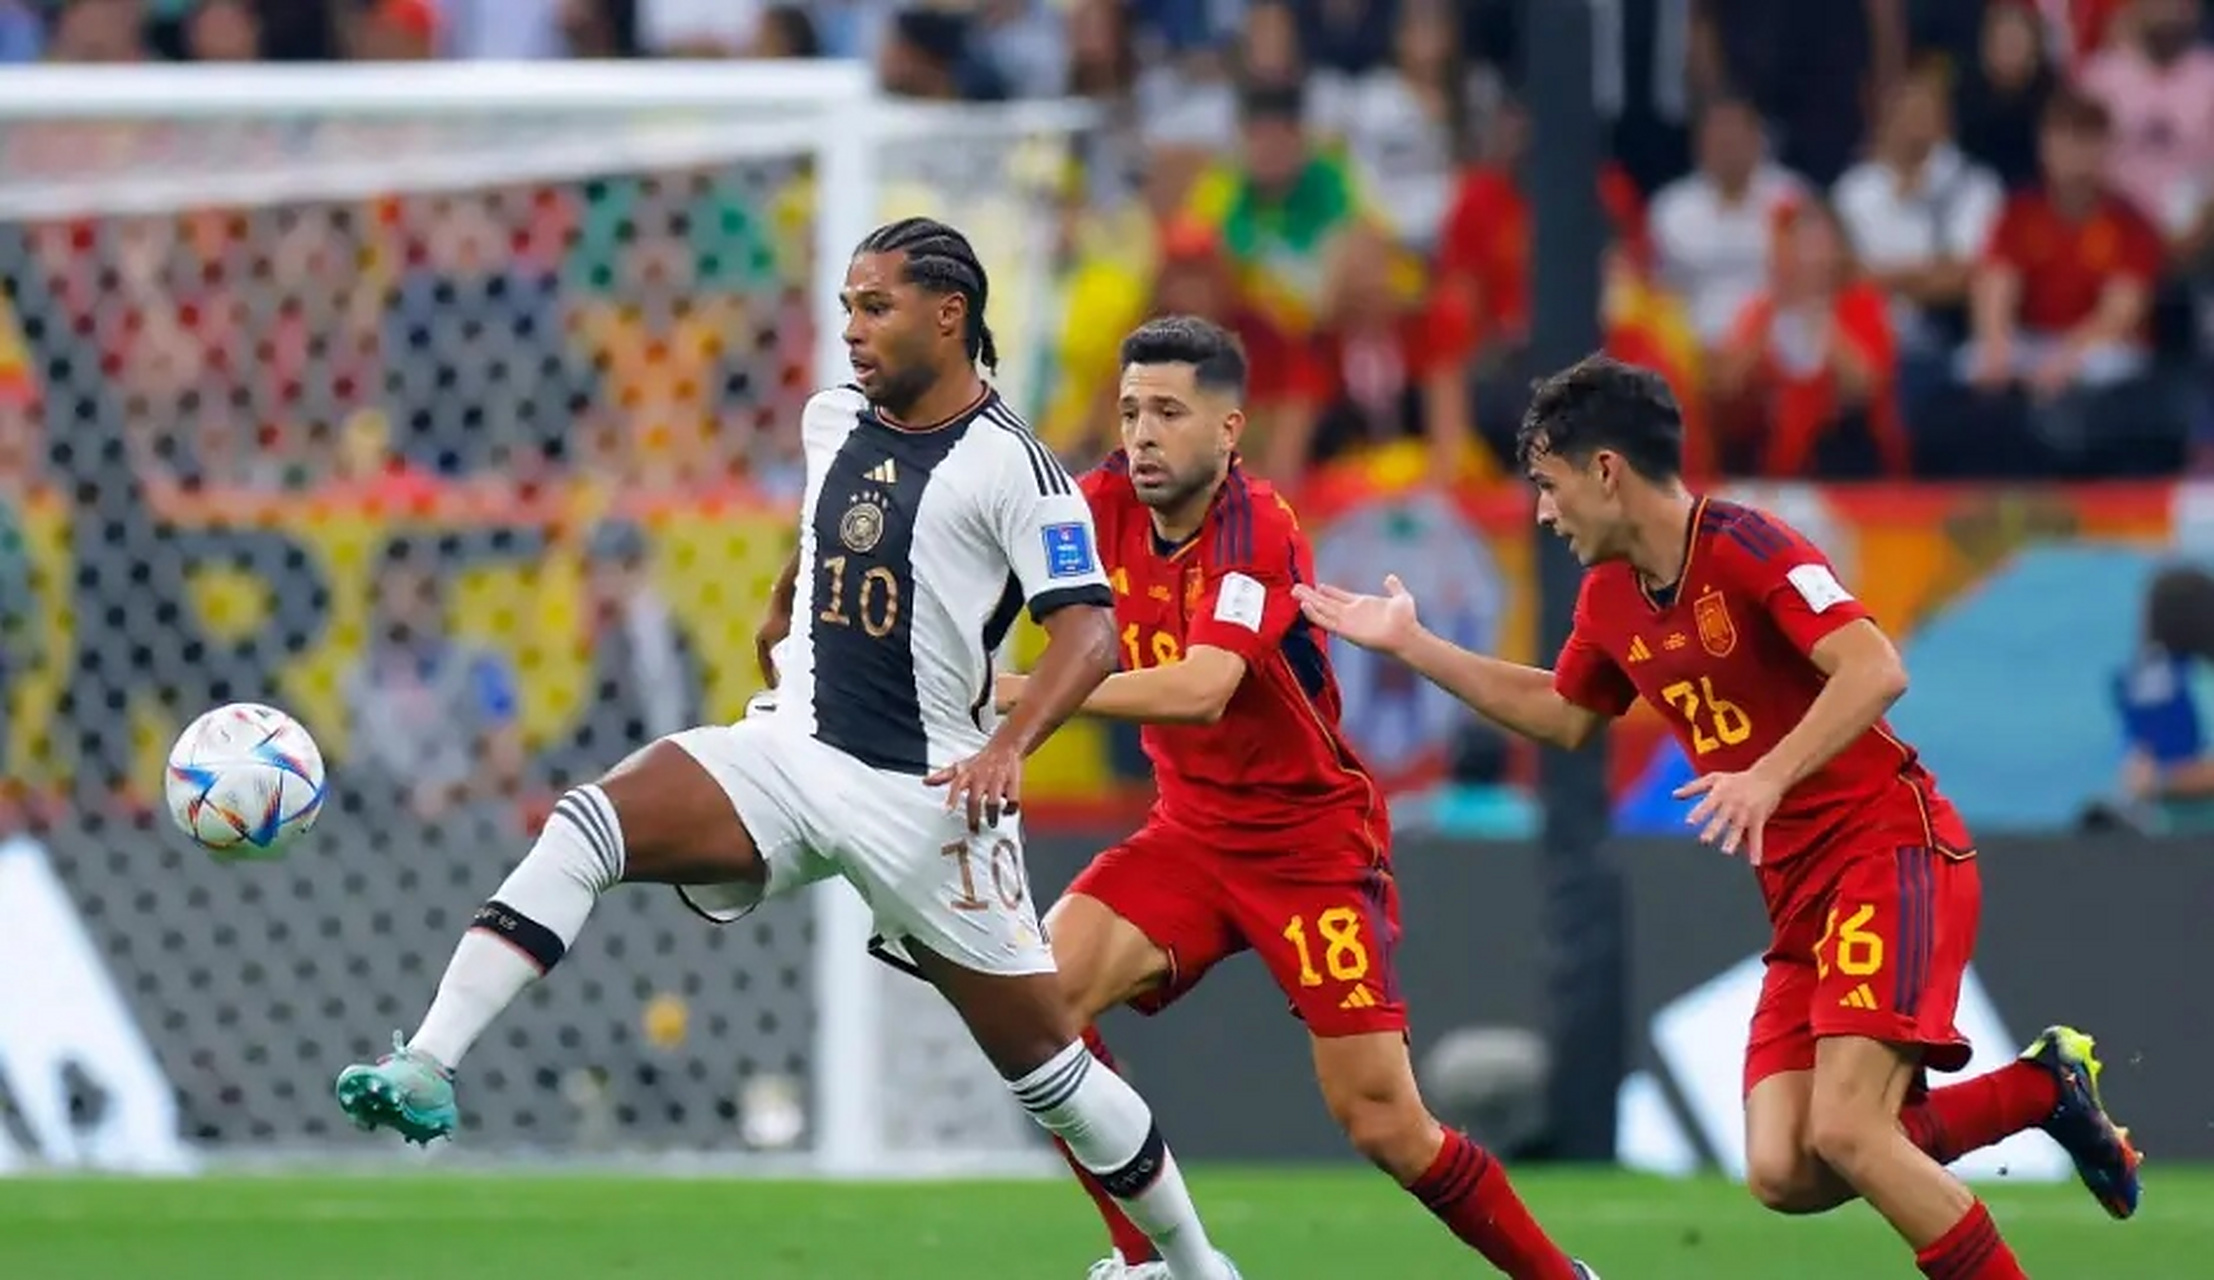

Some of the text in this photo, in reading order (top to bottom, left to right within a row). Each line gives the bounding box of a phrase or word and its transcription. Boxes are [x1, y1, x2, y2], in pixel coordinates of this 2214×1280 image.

[820, 555, 898, 637] 10
[1661, 676, 1751, 754] 26
[941, 838, 1022, 911] 10
[1283, 907, 1368, 986] 18
